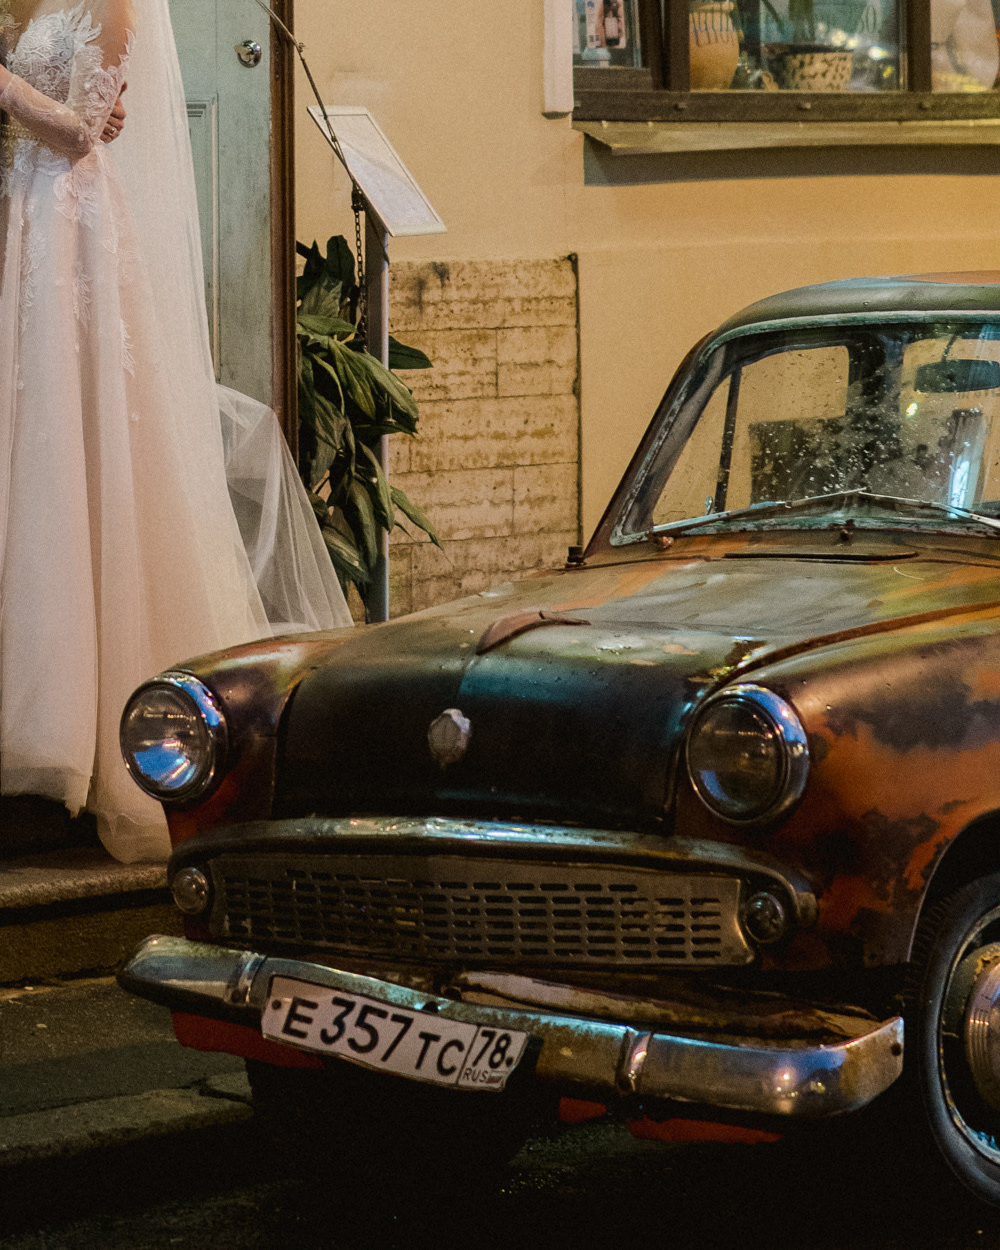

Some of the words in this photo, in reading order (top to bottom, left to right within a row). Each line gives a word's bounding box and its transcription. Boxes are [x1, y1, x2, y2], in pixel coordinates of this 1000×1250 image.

[281, 996, 465, 1077] E357TC
[472, 1030, 512, 1069] 78
[462, 1066, 489, 1084] RUS
